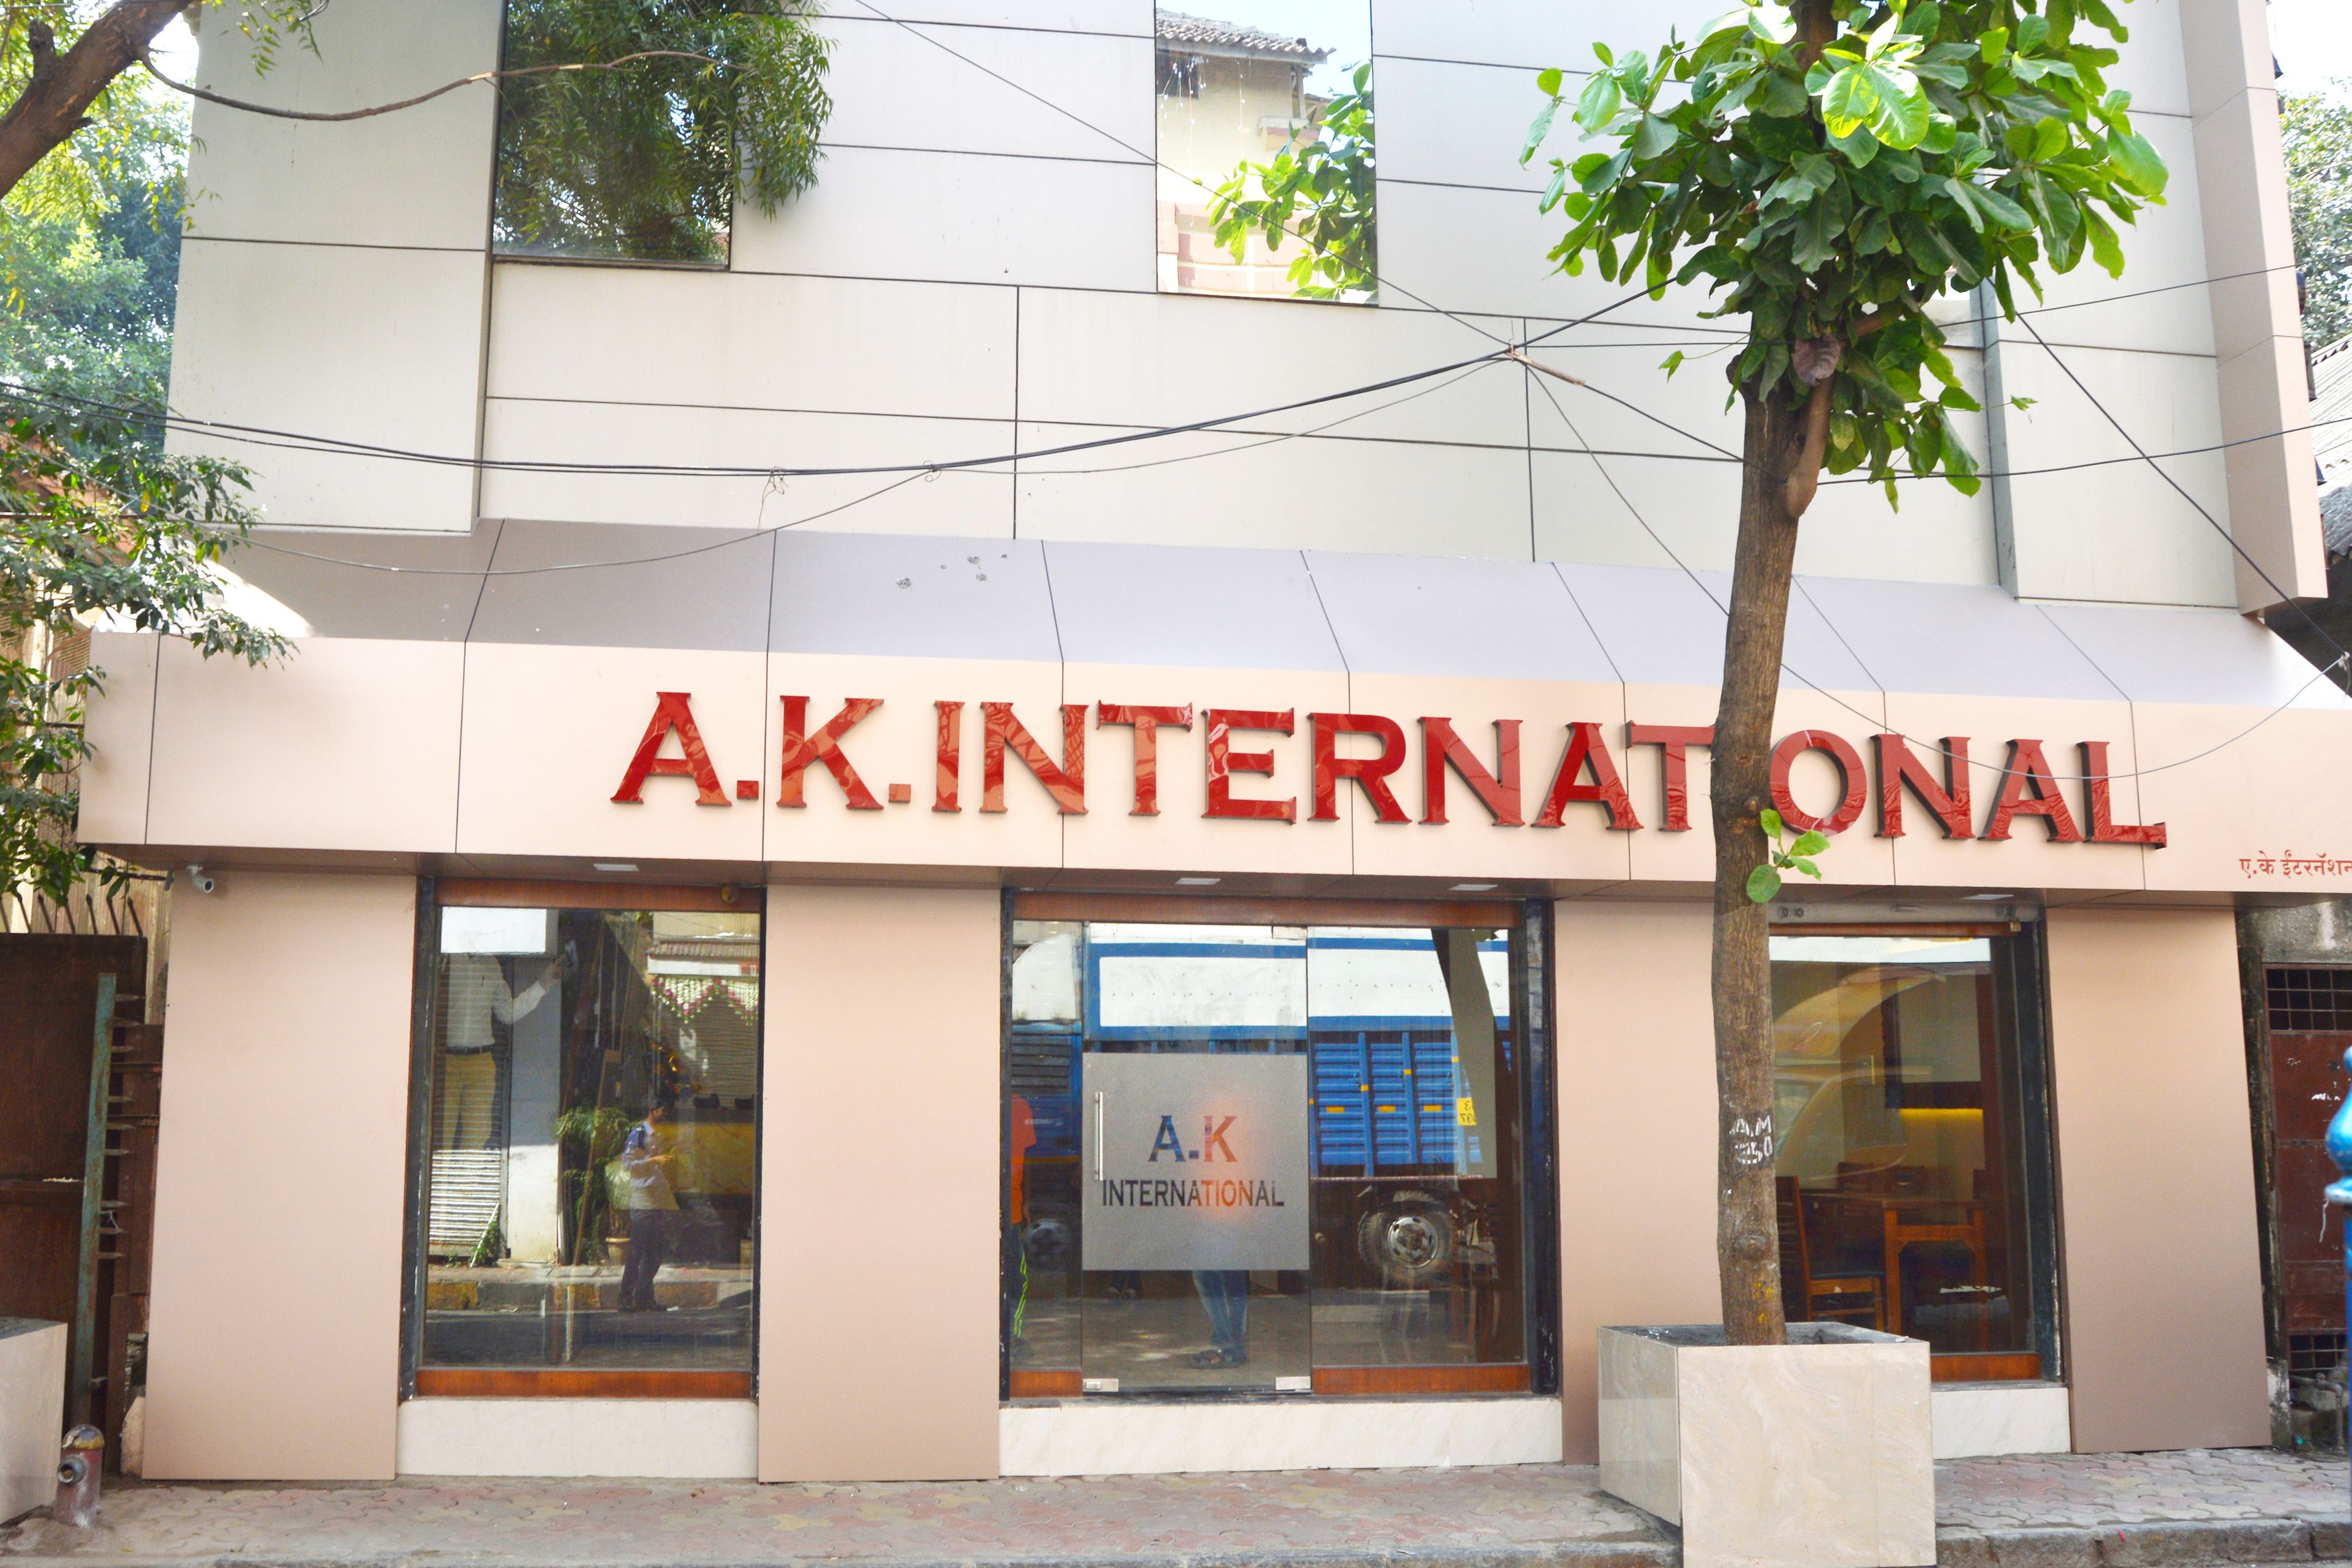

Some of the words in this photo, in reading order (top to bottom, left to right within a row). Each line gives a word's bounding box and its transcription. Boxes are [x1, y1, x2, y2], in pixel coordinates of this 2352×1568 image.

[609, 692, 2166, 850] A.K.INTERNATONAL
[1147, 1115, 1238, 1163] A.K
[1102, 1179, 1285, 1207] INTERNATIONAL
